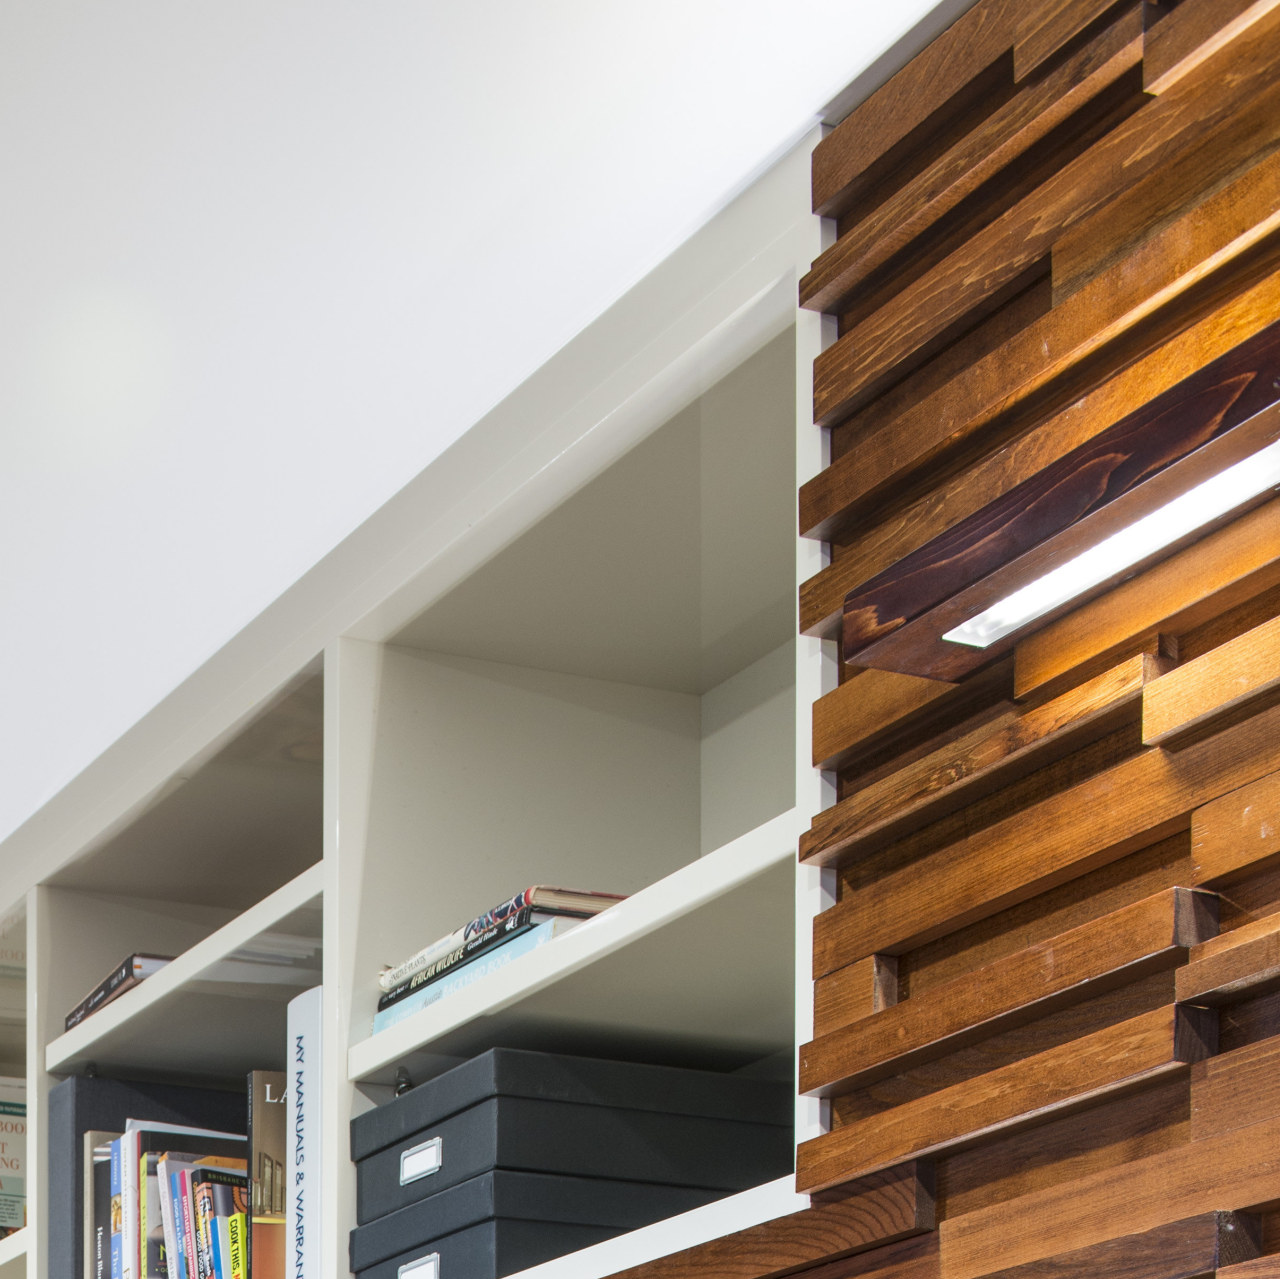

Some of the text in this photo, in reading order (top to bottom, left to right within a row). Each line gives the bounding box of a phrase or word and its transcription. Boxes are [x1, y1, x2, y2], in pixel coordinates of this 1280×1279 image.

[410, 965, 436, 989] AFRICAN
[436, 946, 465, 975] WILDLIFE
[467, 936, 483, 951] Gerald
[295, 1035, 305, 1064] MY
[295, 1071, 305, 1166] MANUALS
[295, 1172, 305, 1186] &
[182, 1195, 190, 1232] EFFORTLESS
[230, 1219, 238, 1247] COOK
[185, 1233, 194, 1279] ENTERTAINING
[231, 1248, 239, 1274] THIS,
